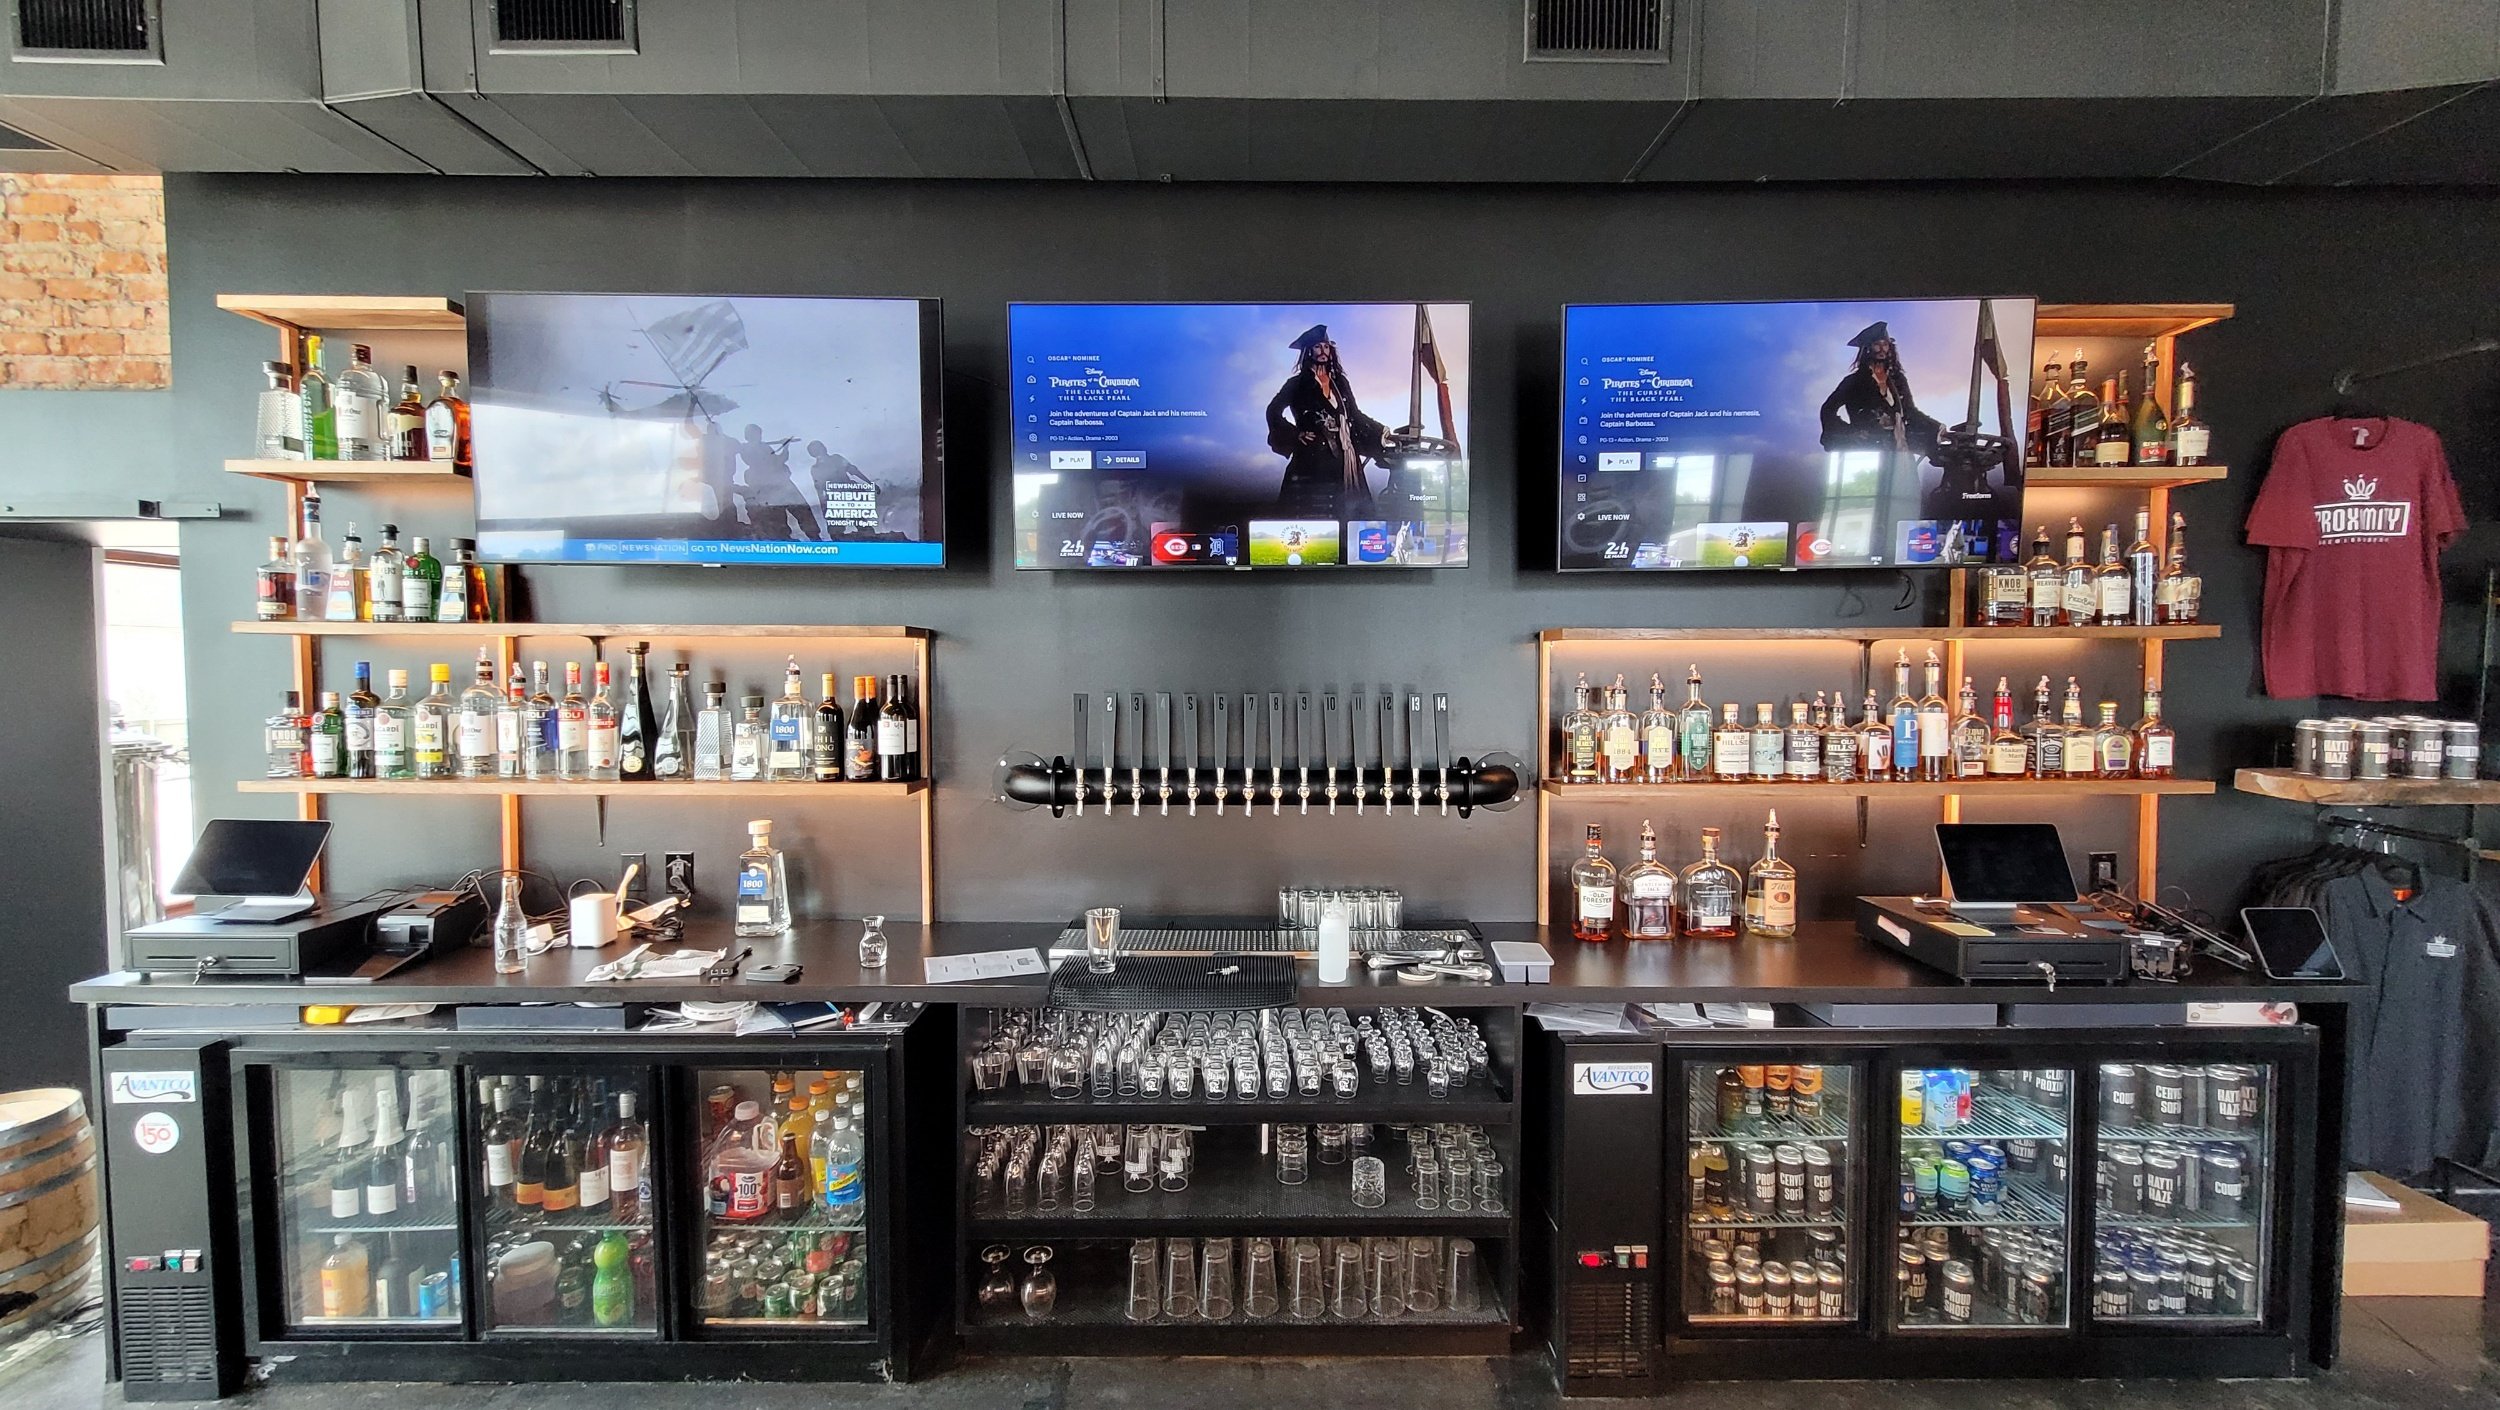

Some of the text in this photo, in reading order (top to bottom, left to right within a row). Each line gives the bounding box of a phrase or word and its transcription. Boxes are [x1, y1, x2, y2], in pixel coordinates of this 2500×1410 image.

[1117, 410, 1141, 418] Captain
[1669, 411, 1693, 419] Captain
[1049, 419, 1073, 427] Captain
[826, 492, 876, 501] TRIBUTE
[825, 510, 879, 519] AMERICA
[720, 543, 838, 554] NewsNationNow.com
[1999, 578, 2021, 589] KNOB
[1078, 698, 1082, 712] 1
[1106, 697, 1113, 711] 2
[1134, 697, 1139, 711] 3
[1188, 697, 1193, 711] 5
[1219, 697, 1224, 711] 6
[1249, 697, 1254, 711] 7
[1274, 697, 1279, 711] 8
[1302, 697, 1307, 711] 9
[1326, 697, 1336, 711] 10
[1355, 697, 1362, 711] 11
[1383, 697, 1392, 711] 12
[1411, 696, 1420, 712] 13
[1437, 696, 1447, 712] 14
[775, 726, 795, 734] 1800
[743, 880, 763, 888] 1800
[2147, 1173, 2173, 1191] HAYTI
[2148, 1187, 2172, 1205] HAZE
[1820, 1290, 1842, 1307] HAYTI
[1944, 1287, 1971, 1306] PROUD
[1944, 1301, 1970, 1318] SHOES
